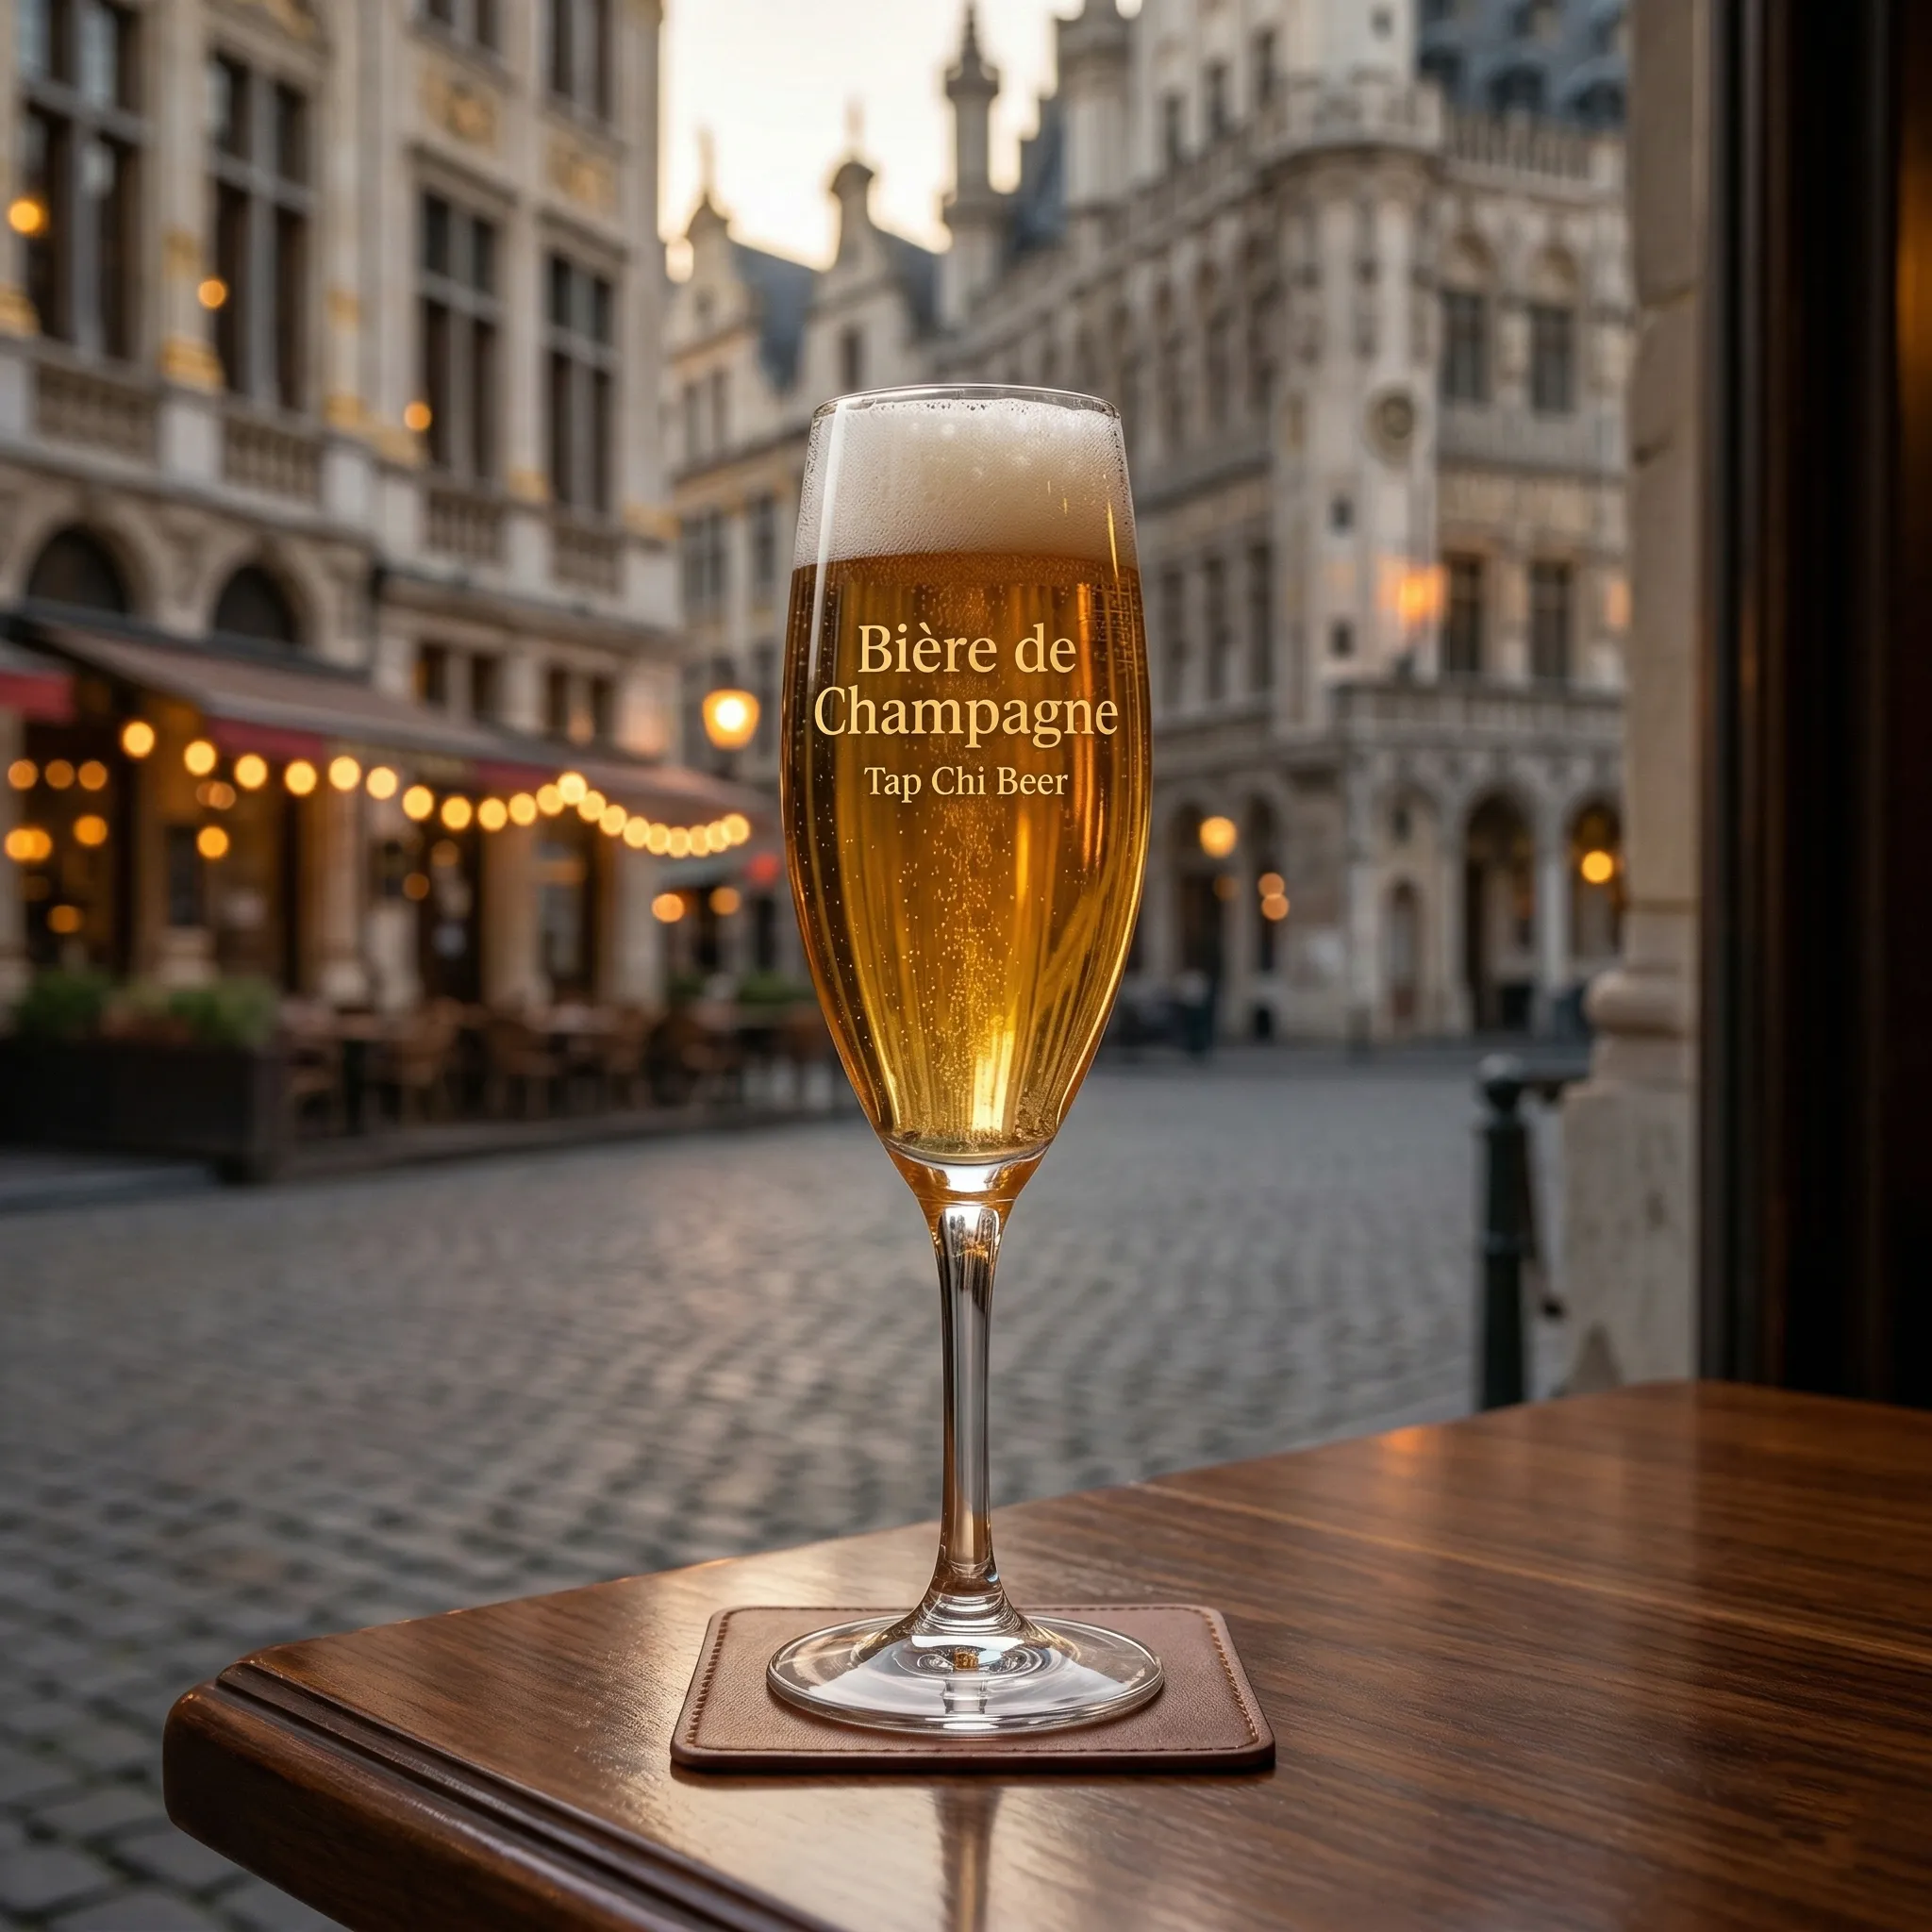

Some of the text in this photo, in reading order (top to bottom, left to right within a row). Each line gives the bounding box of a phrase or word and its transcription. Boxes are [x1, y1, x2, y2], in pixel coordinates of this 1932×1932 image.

[858, 622, 1076, 673] Bière de
[814, 685, 1118, 748] Champagne
[864, 765, 1069, 803] Tap Chi Beer
